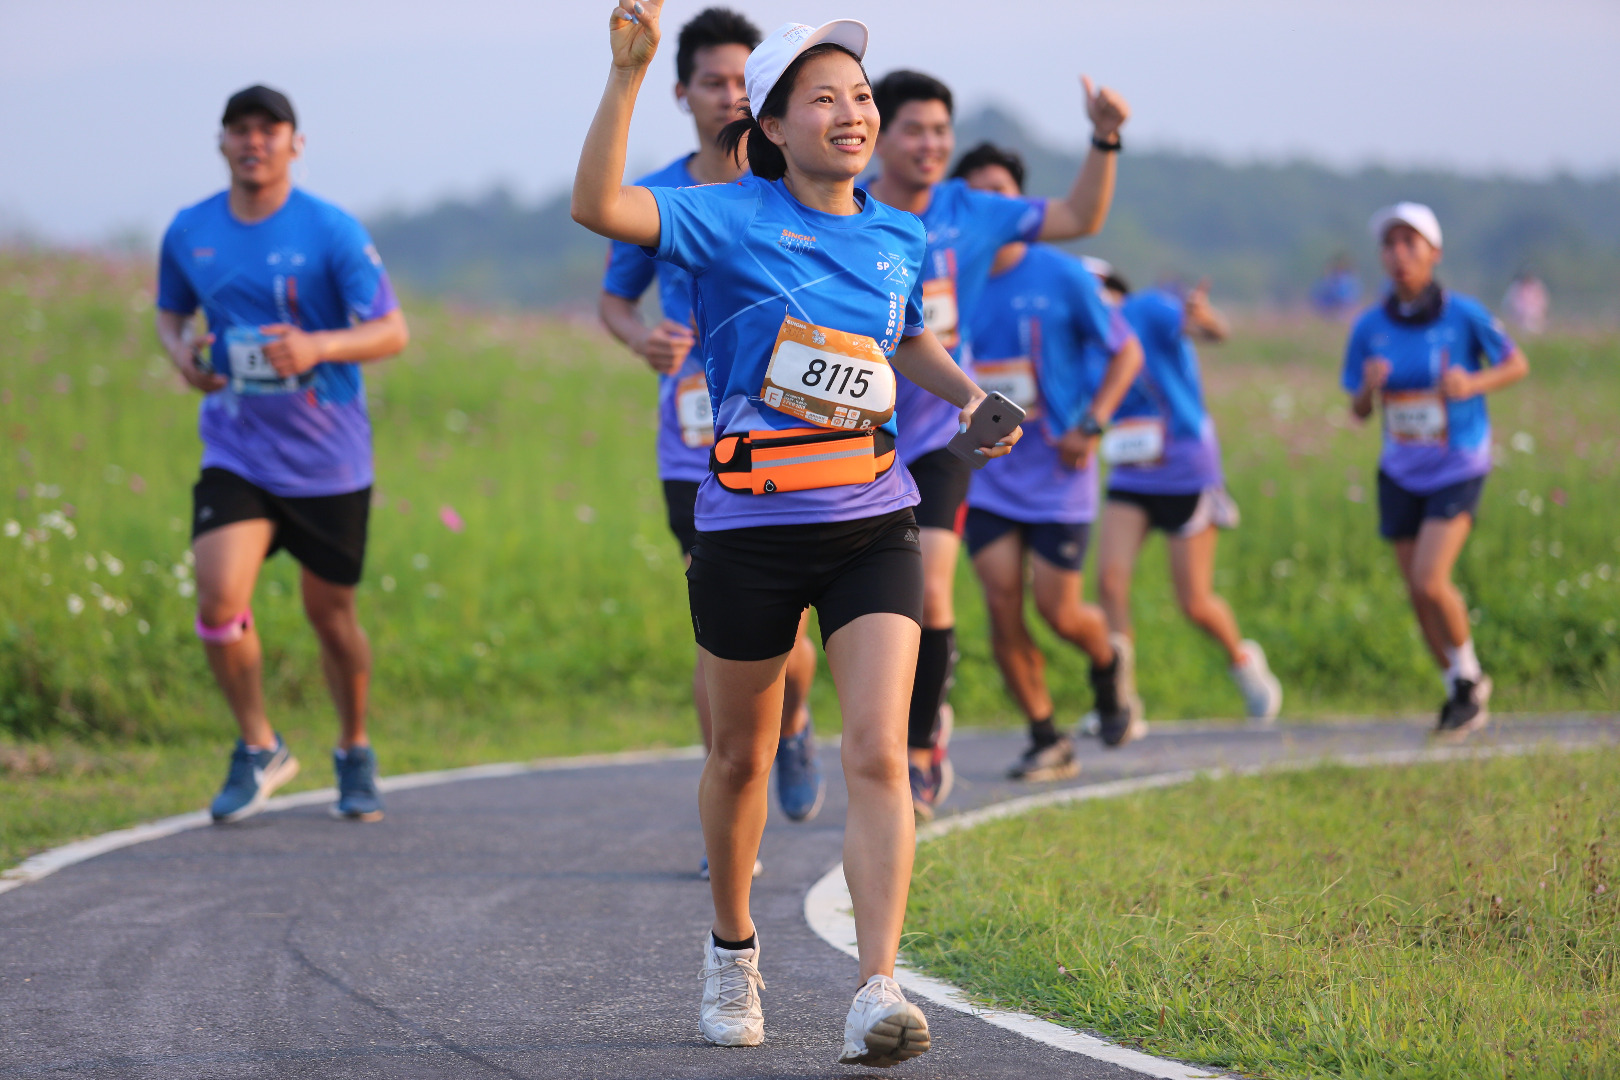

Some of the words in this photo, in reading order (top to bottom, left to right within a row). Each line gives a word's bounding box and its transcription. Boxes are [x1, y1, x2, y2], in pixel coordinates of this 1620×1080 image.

[781, 229, 816, 242] SINGHA
[876, 261, 890, 271] SP
[885, 291, 897, 336] CROSS
[801, 358, 874, 399] 8115
[769, 392, 779, 402] F
